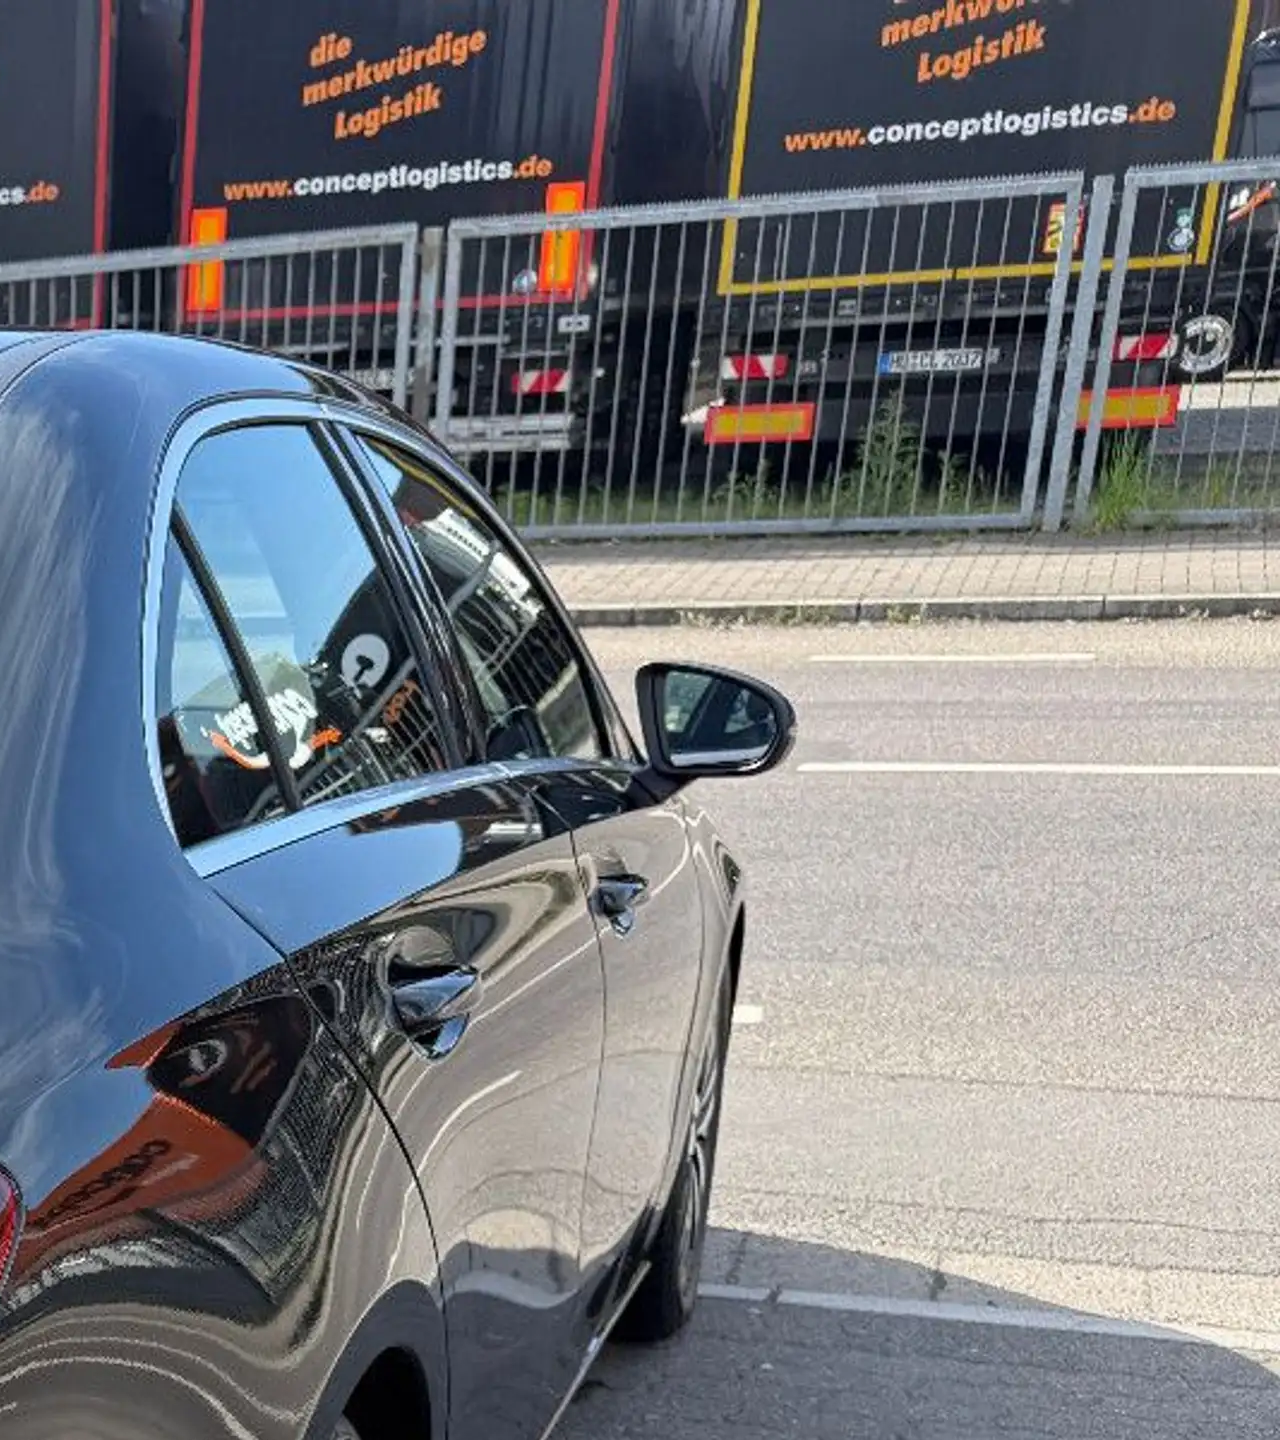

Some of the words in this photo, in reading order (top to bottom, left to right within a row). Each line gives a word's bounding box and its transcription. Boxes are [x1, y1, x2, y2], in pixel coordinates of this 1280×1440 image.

[301, 29, 489, 107] merkwürdige
[309, 31, 353, 68] die
[916, 19, 1047, 83] Logistik
[334, 81, 442, 140] Logistik
[783, 96, 1177, 153] www.conceptlogistics.de
[223, 154, 554, 201] www.conceptlogistics.de
